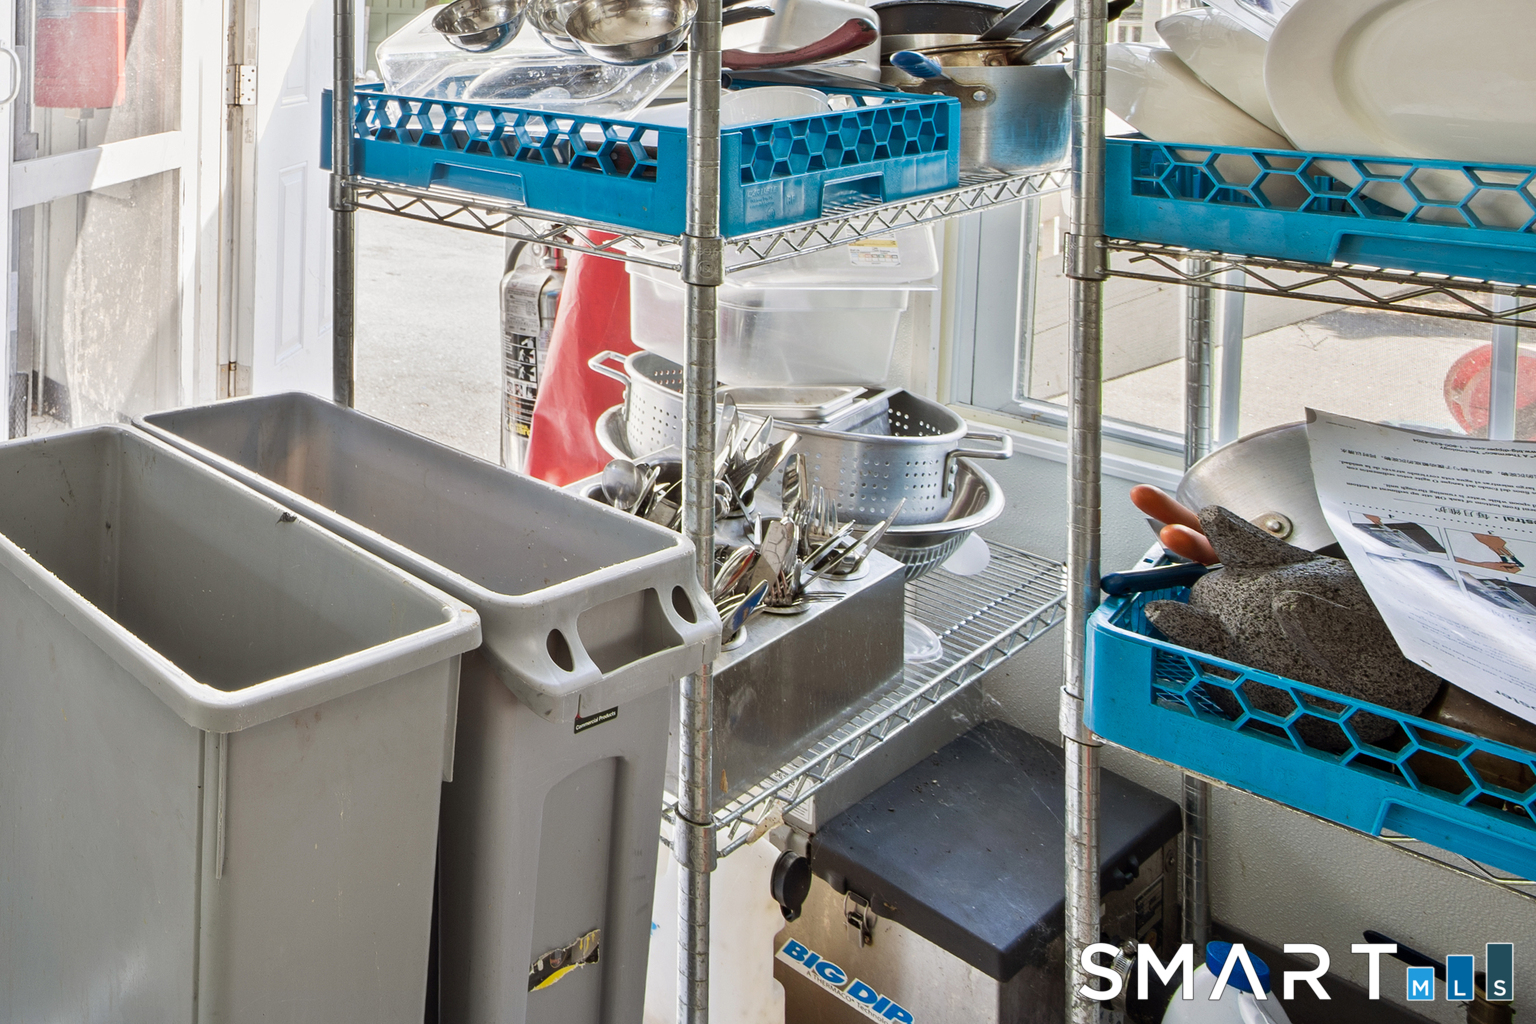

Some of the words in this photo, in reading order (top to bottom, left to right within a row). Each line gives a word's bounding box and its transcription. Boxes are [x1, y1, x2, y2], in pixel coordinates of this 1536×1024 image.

[575, 716, 599, 731] Commercial
[599, 711, 616, 722] Products
[782, 939, 847, 985] BIG
